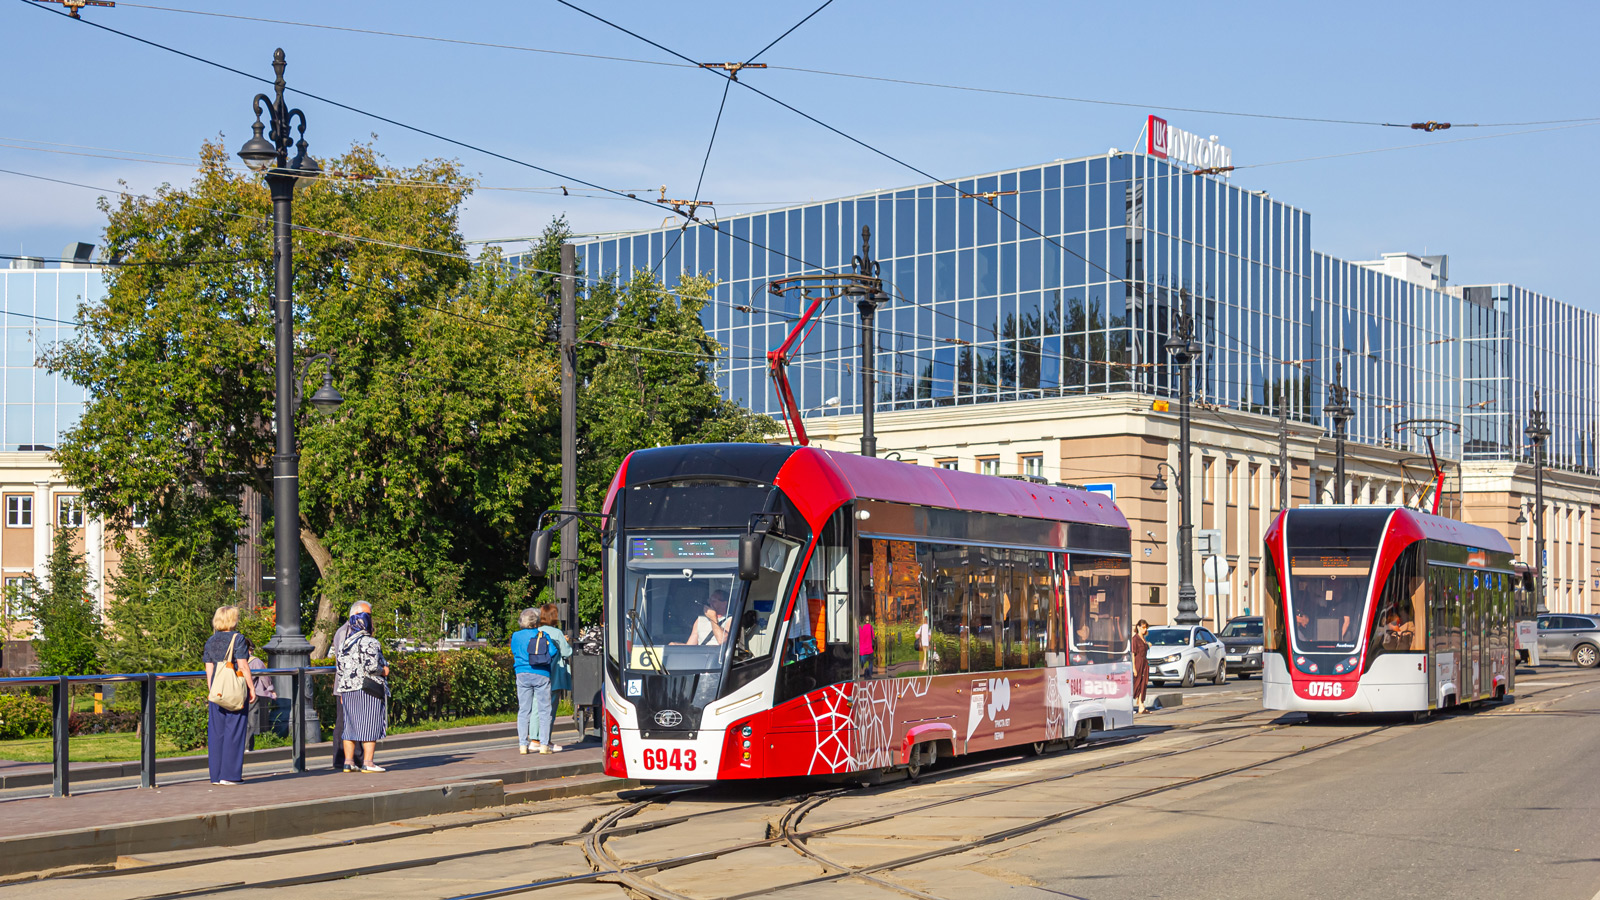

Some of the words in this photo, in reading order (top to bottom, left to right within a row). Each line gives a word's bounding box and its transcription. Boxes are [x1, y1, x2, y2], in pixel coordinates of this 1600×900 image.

[1167, 125, 1232, 178] ЛУКОЙЛ
[639, 650, 653, 667] 6
[1308, 681, 1343, 697] 0756
[643, 748, 697, 771] 6943
